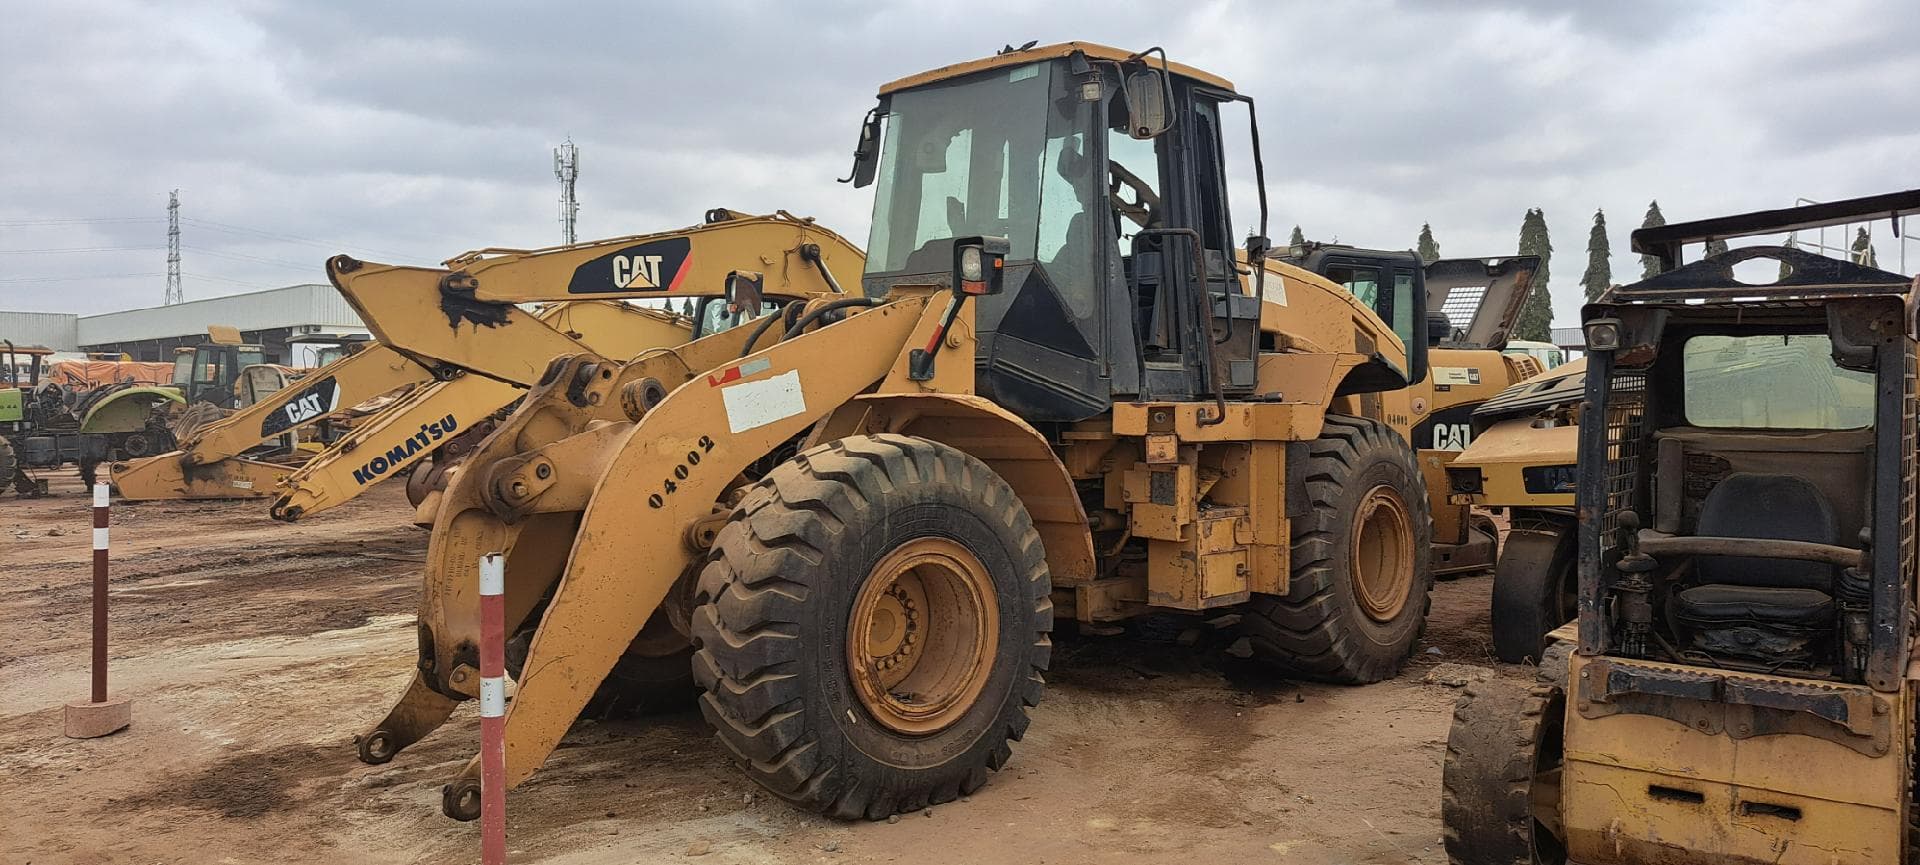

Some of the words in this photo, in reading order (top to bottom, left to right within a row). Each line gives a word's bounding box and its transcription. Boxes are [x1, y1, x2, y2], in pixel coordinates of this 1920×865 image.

[613, 255, 662, 288] CAT
[285, 393, 322, 423] CAT
[352, 414, 457, 485] KOMATSU
[1433, 423, 1471, 452] CAT
[648, 435, 715, 509] 04002
